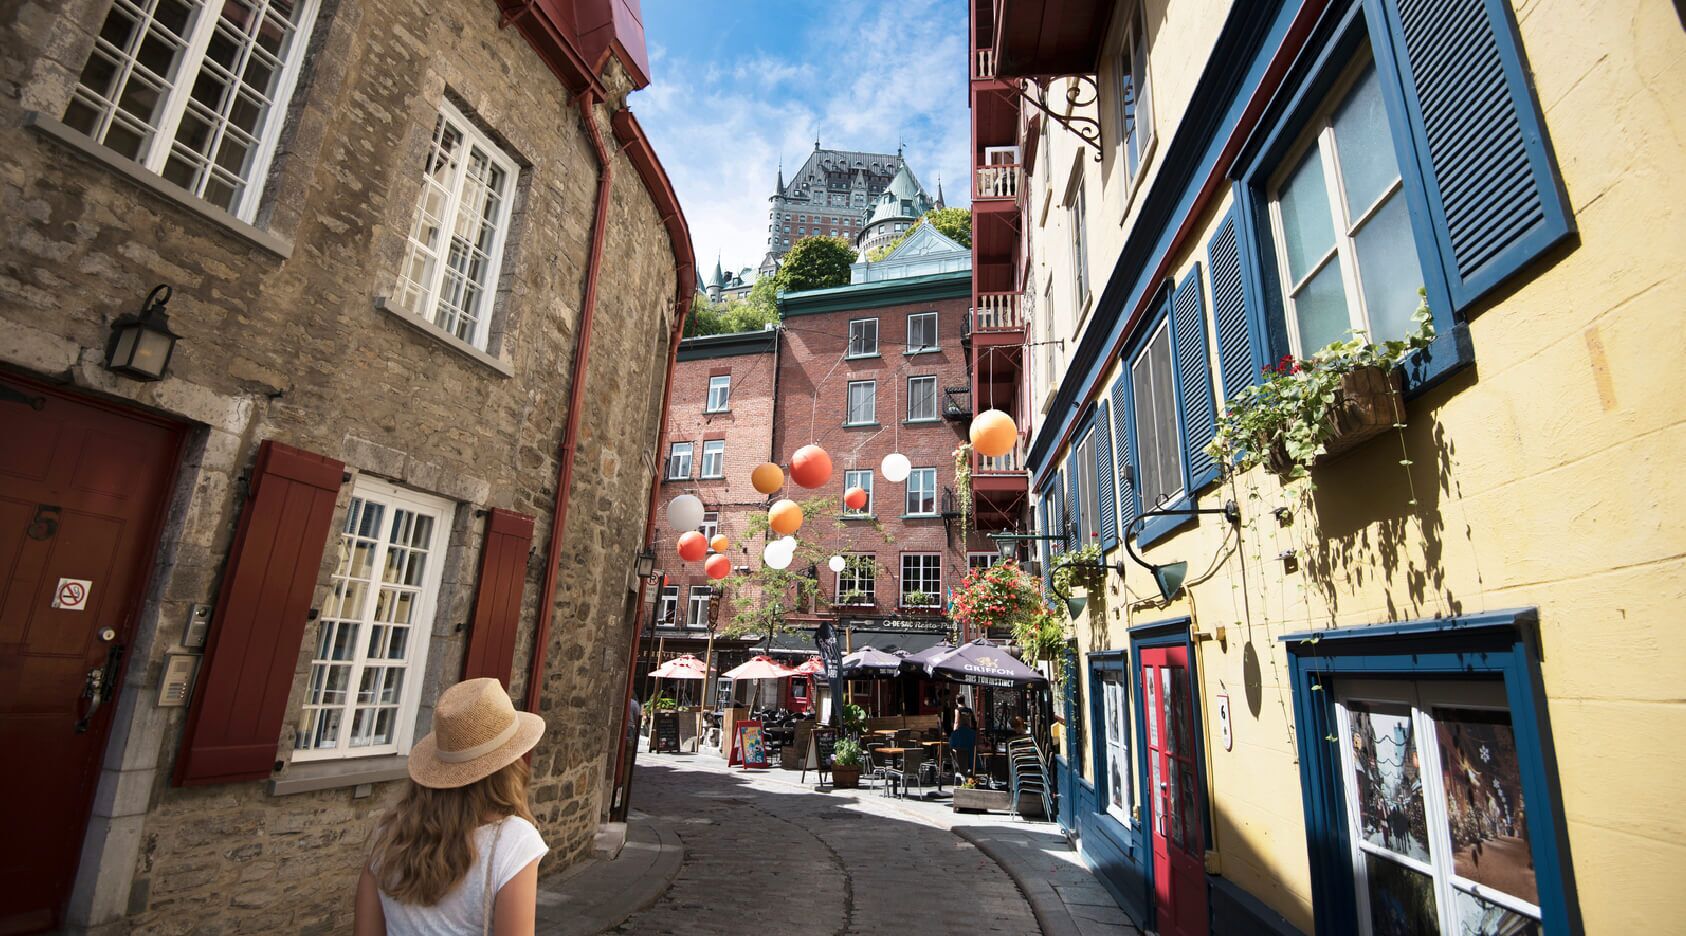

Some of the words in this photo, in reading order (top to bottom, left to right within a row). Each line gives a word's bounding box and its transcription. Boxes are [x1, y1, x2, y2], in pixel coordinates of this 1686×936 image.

[28, 504, 62, 541] 5
[963, 664, 1014, 676] GRIFFON
[1220, 704, 1226, 720] 6
